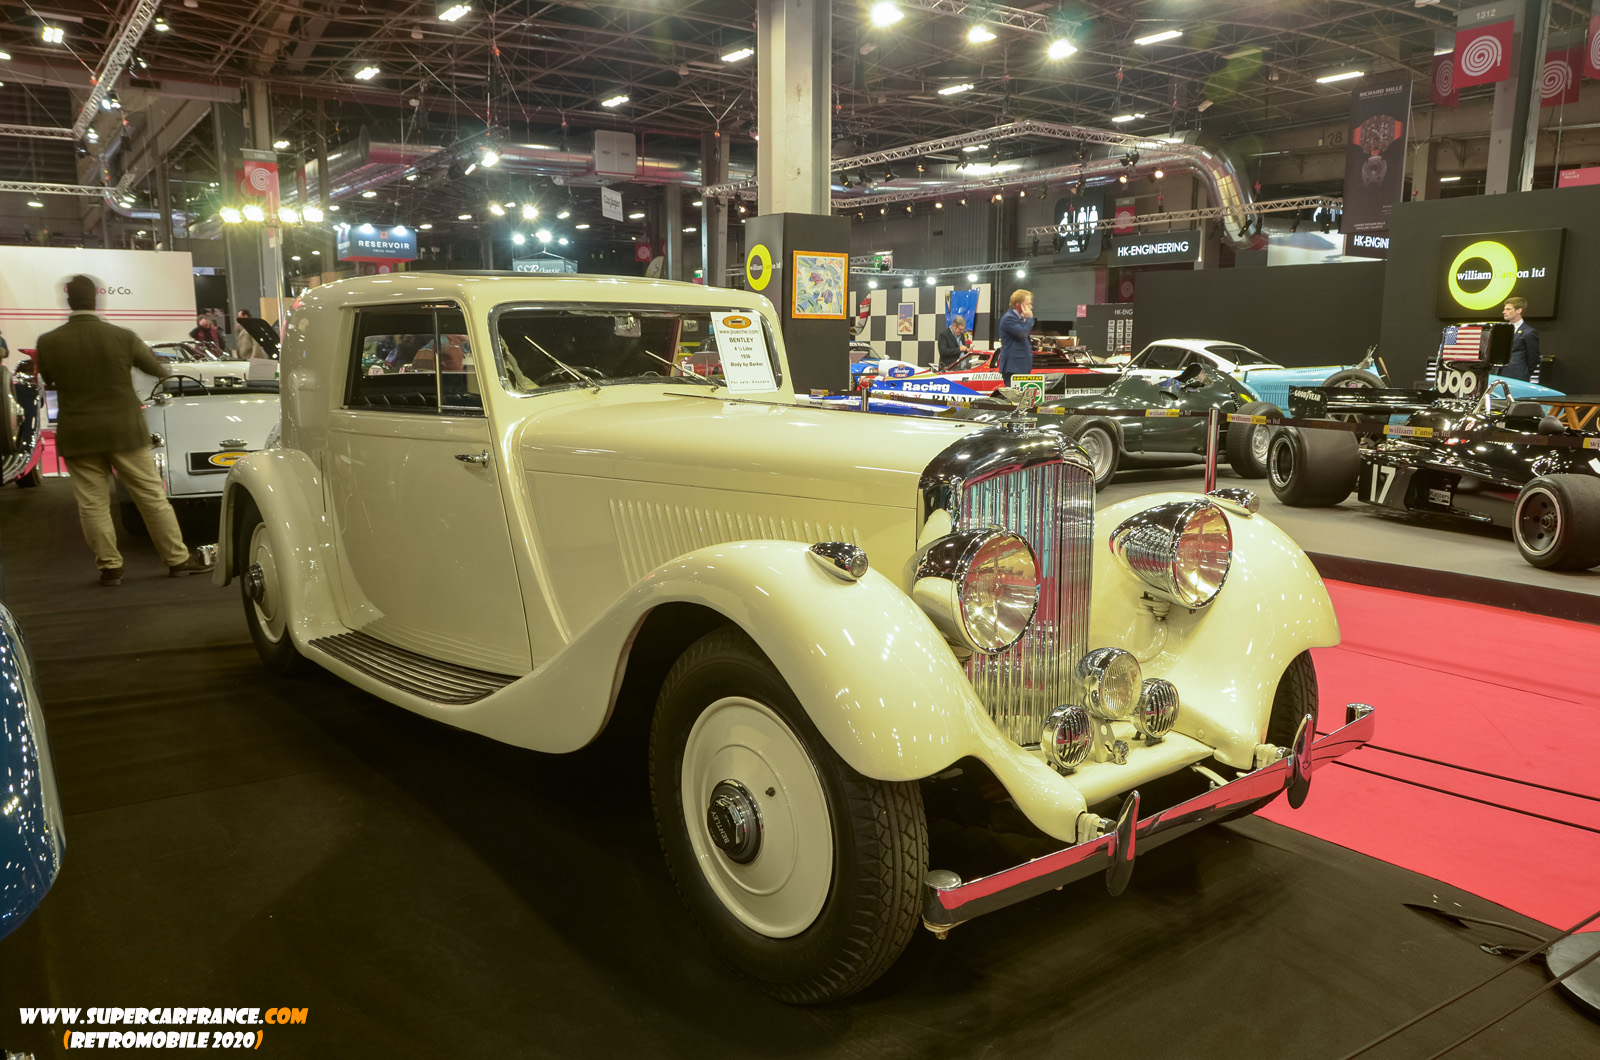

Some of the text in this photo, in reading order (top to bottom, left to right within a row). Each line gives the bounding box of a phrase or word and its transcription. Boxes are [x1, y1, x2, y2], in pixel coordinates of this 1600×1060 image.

[1476, 8, 1496, 20] 1312
[358, 239, 410, 250] RESERVOIR
[1117, 240, 1189, 257] HK-ENGINEERING
[1456, 269, 1492, 280] william
[1531, 267, 1546, 278] ltd
[117, 286, 133, 295] Co.
[728, 336, 754, 344] BENTLEY
[902, 381, 951, 393] Racing
[1389, 426, 1414, 435] william
[1369, 463, 1397, 504] 17
[710, 811, 730, 844] BENTLEY
